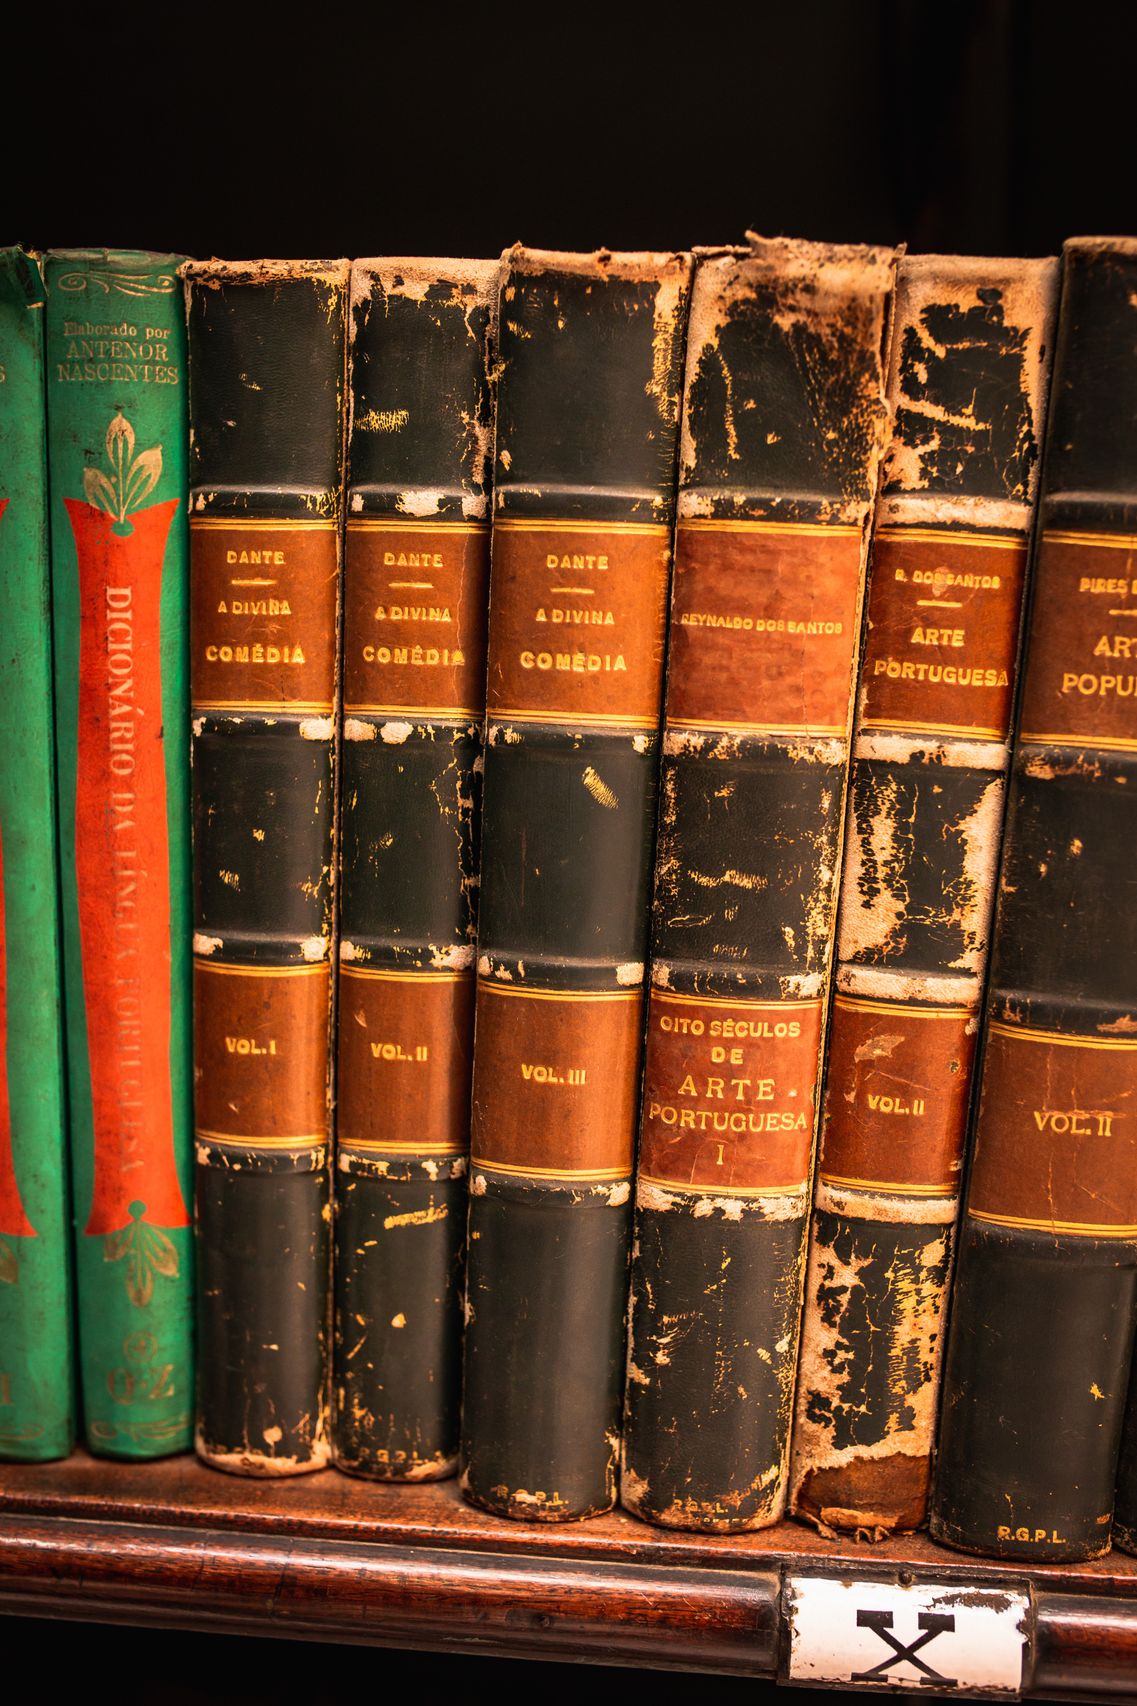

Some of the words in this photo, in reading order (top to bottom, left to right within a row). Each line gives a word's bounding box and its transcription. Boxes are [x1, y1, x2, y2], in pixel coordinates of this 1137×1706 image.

[63, 322, 137, 337] Elaborado
[145, 327, 171, 340] por
[66, 341, 169, 361] ANTENOR
[58, 363, 180, 385] NASCENTES
[226, 550, 286, 565] DANTE
[384, 552, 444, 568] DANTE
[546, 554, 609, 570] DANTE
[944, 573, 1001, 589] SANTOS
[1079, 577, 1129, 594] PIRES
[217, 601, 227, 614] A
[232, 598, 292, 615] DIVINA
[374, 606, 386, 621] A
[390, 606, 452, 622] DIVINA
[536, 608, 547, 622] A
[552, 608, 615, 625] DIVINA
[681, 613, 753, 630] REYNALDO
[755, 618, 785, 633] DOS
[786, 619, 843, 635] SANTOS
[910, 627, 966, 648] ARTE
[205, 643, 306, 664] COMÉDIA
[520, 651, 627, 673] COMÉDIA
[106, 586, 144, 776] DICIONÁRIO
[873, 660, 1009, 687] PORTUGUESA
[1061, 672, 1137, 697] POPU
[660, 1016, 704, 1036] OITO
[709, 1017, 801, 1039] SÉCULOS
[711, 1046, 744, 1065] DE
[677, 1075, 776, 1101] ARTE
[649, 1103, 808, 1133] PORTUGUESA
[715, 1144, 725, 1165] I
[850, 1609, 958, 1687] X
